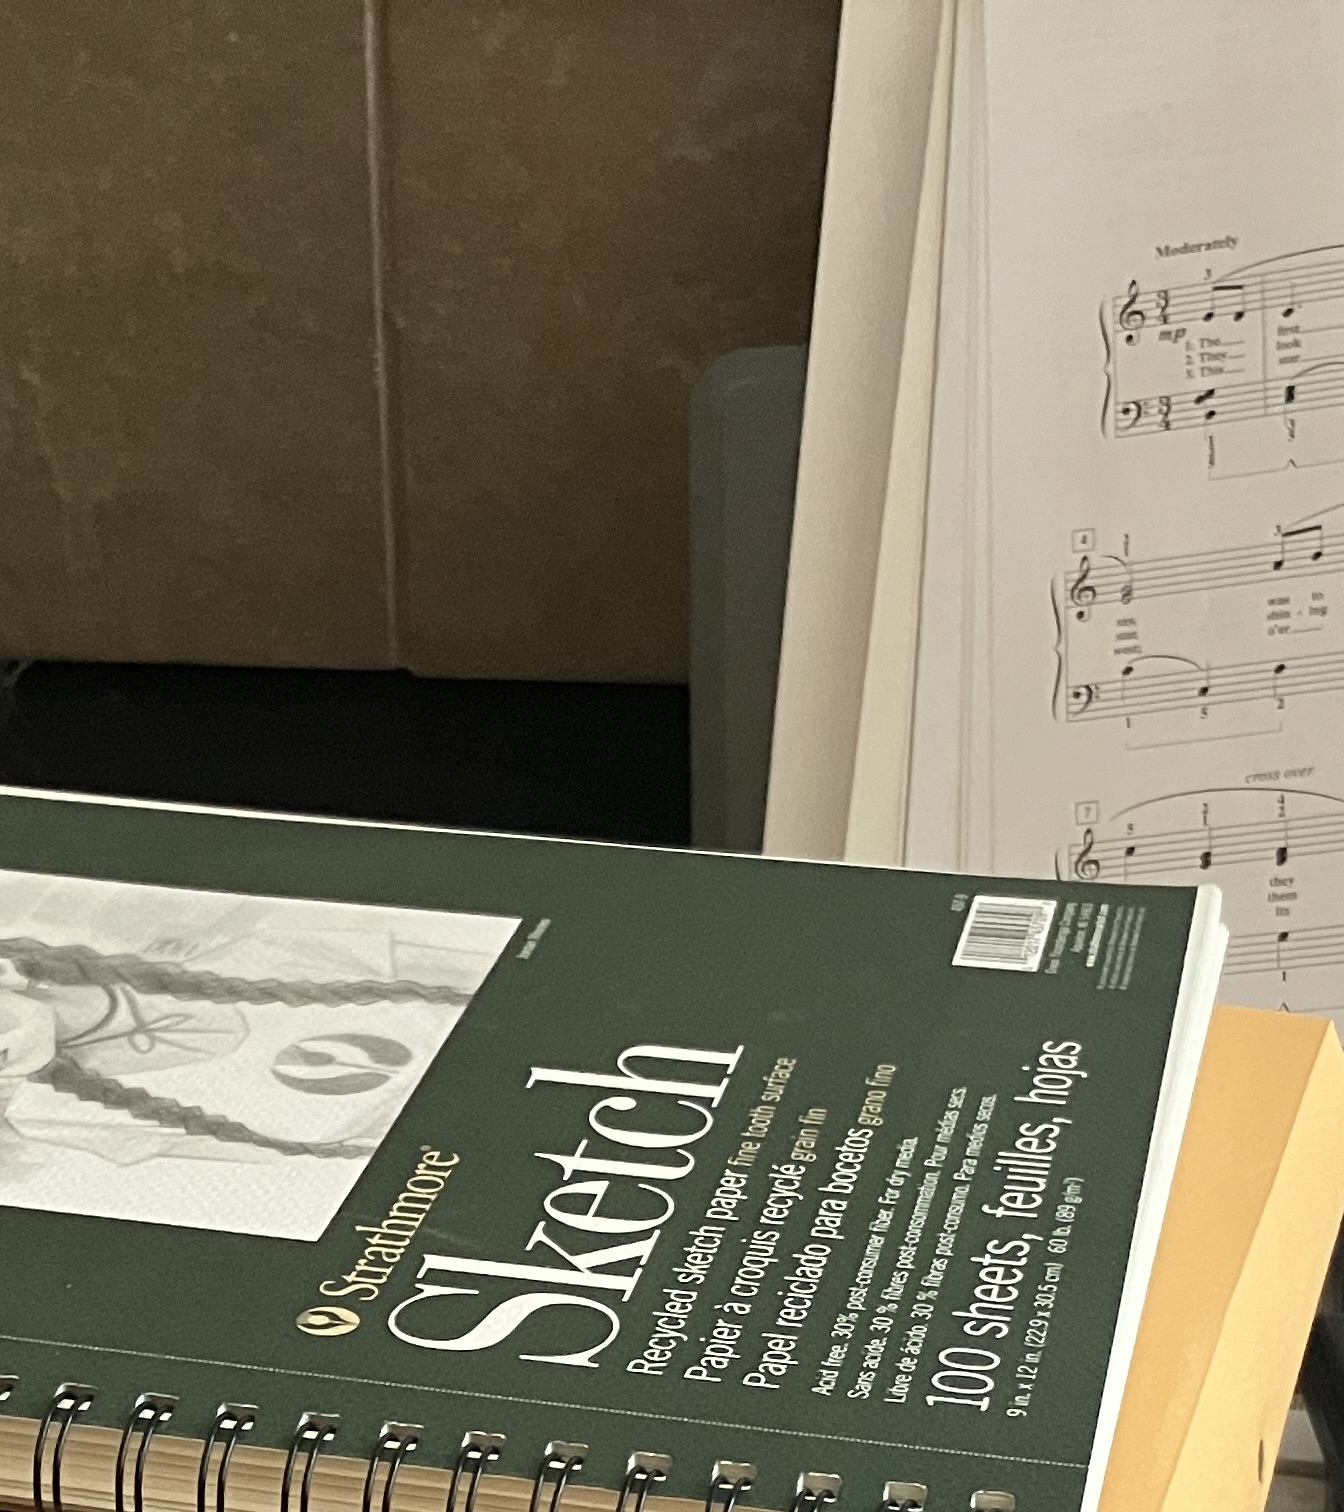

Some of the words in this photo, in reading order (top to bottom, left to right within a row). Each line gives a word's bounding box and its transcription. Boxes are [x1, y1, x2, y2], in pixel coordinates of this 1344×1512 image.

[761, 1057, 797, 1102] surface
[1013, 1039, 1089, 1106] hojas
[741, 1105, 777, 1139] tooth
[857, 1090, 887, 1127] grano
[728, 1139, 761, 1167] fine
[790, 1128, 819, 1163] grain
[817, 1127, 874, 1195] bocetos
[924, 1144, 948, 1168] Pour
[885, 1169, 913, 1187] dry
[953, 1158, 978, 1181] Para
[981, 1117, 1073, 1220] feuilles,
[388, 1045, 744, 1367] Sketch
[706, 1168, 748, 1221] paper
[759, 1163, 806, 1225] recyclé
[878, 1187, 901, 1205] For
[319, 1150, 460, 1301] Strathmore
[810, 1198, 848, 1240] para
[672, 1225, 726, 1285] sketch
[730, 1229, 780, 1297] croquis
[1047, 1238, 1069, 1254] 60
[776, 1243, 832, 1328] reciclado
[952, 1231, 1044, 1340] sheets,
[1033, 1284, 1058, 1310] 30.5
[713, 1301, 752, 1315] à
[869, 1316, 894, 1334] 30
[910, 1303, 935, 1320] 30
[626, 1288, 697, 1375] Recycled
[830, 1312, 859, 1340] 30%
[683, 1319, 743, 1382] Papier
[742, 1332, 799, 1389] Papel
[820, 1343, 849, 1367] free.
[860, 1337, 888, 1369] acide.
[894, 1357, 918, 1373] de
[811, 1369, 839, 1396] Acid
[846, 1371, 876, 1399] Sans
[883, 1374, 913, 1404] Libre
[926, 1347, 1002, 1412] 100
[1015, 1364, 1039, 1380] 12
[1006, 1407, 1028, 1418] 9
